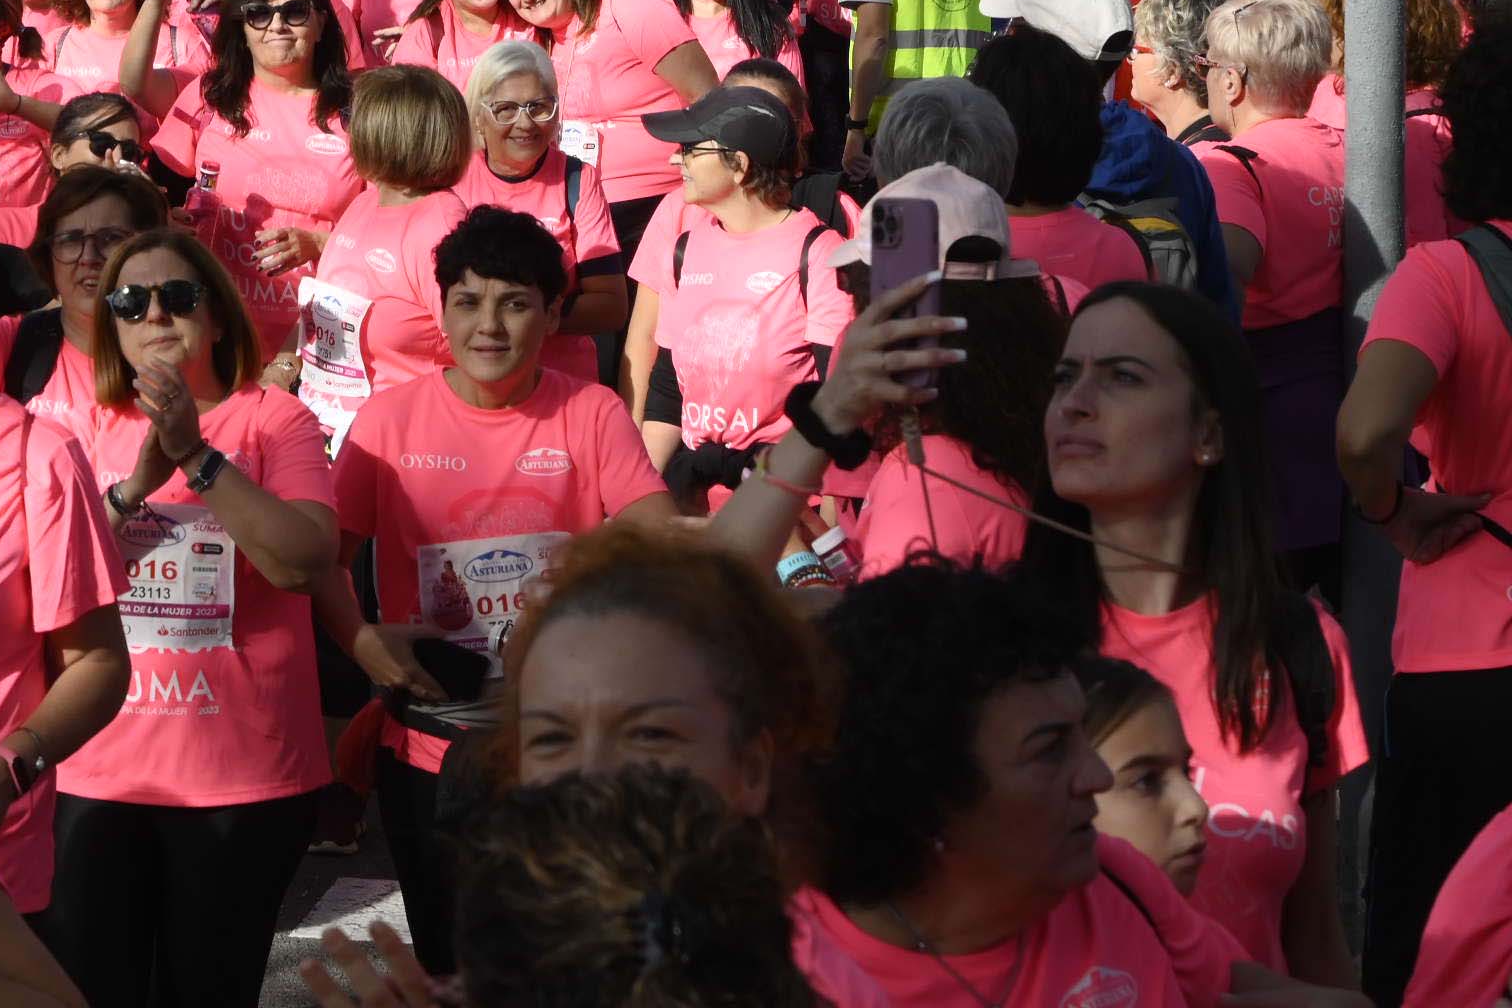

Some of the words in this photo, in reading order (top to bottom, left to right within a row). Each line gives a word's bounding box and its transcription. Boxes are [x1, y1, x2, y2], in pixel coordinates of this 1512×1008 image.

[400, 453, 466, 472] OYSHO
[519, 458, 569, 470] ASTURIANA
[126, 559, 178, 581] 016
[470, 560, 529, 577] ASTURIANA
[130, 586, 171, 600] 23113
[134, 605, 146, 614] DE
[147, 606, 159, 615] LA
[161, 606, 192, 616] MUJER
[196, 607, 217, 616] 2023
[170, 625, 218, 637] Santander
